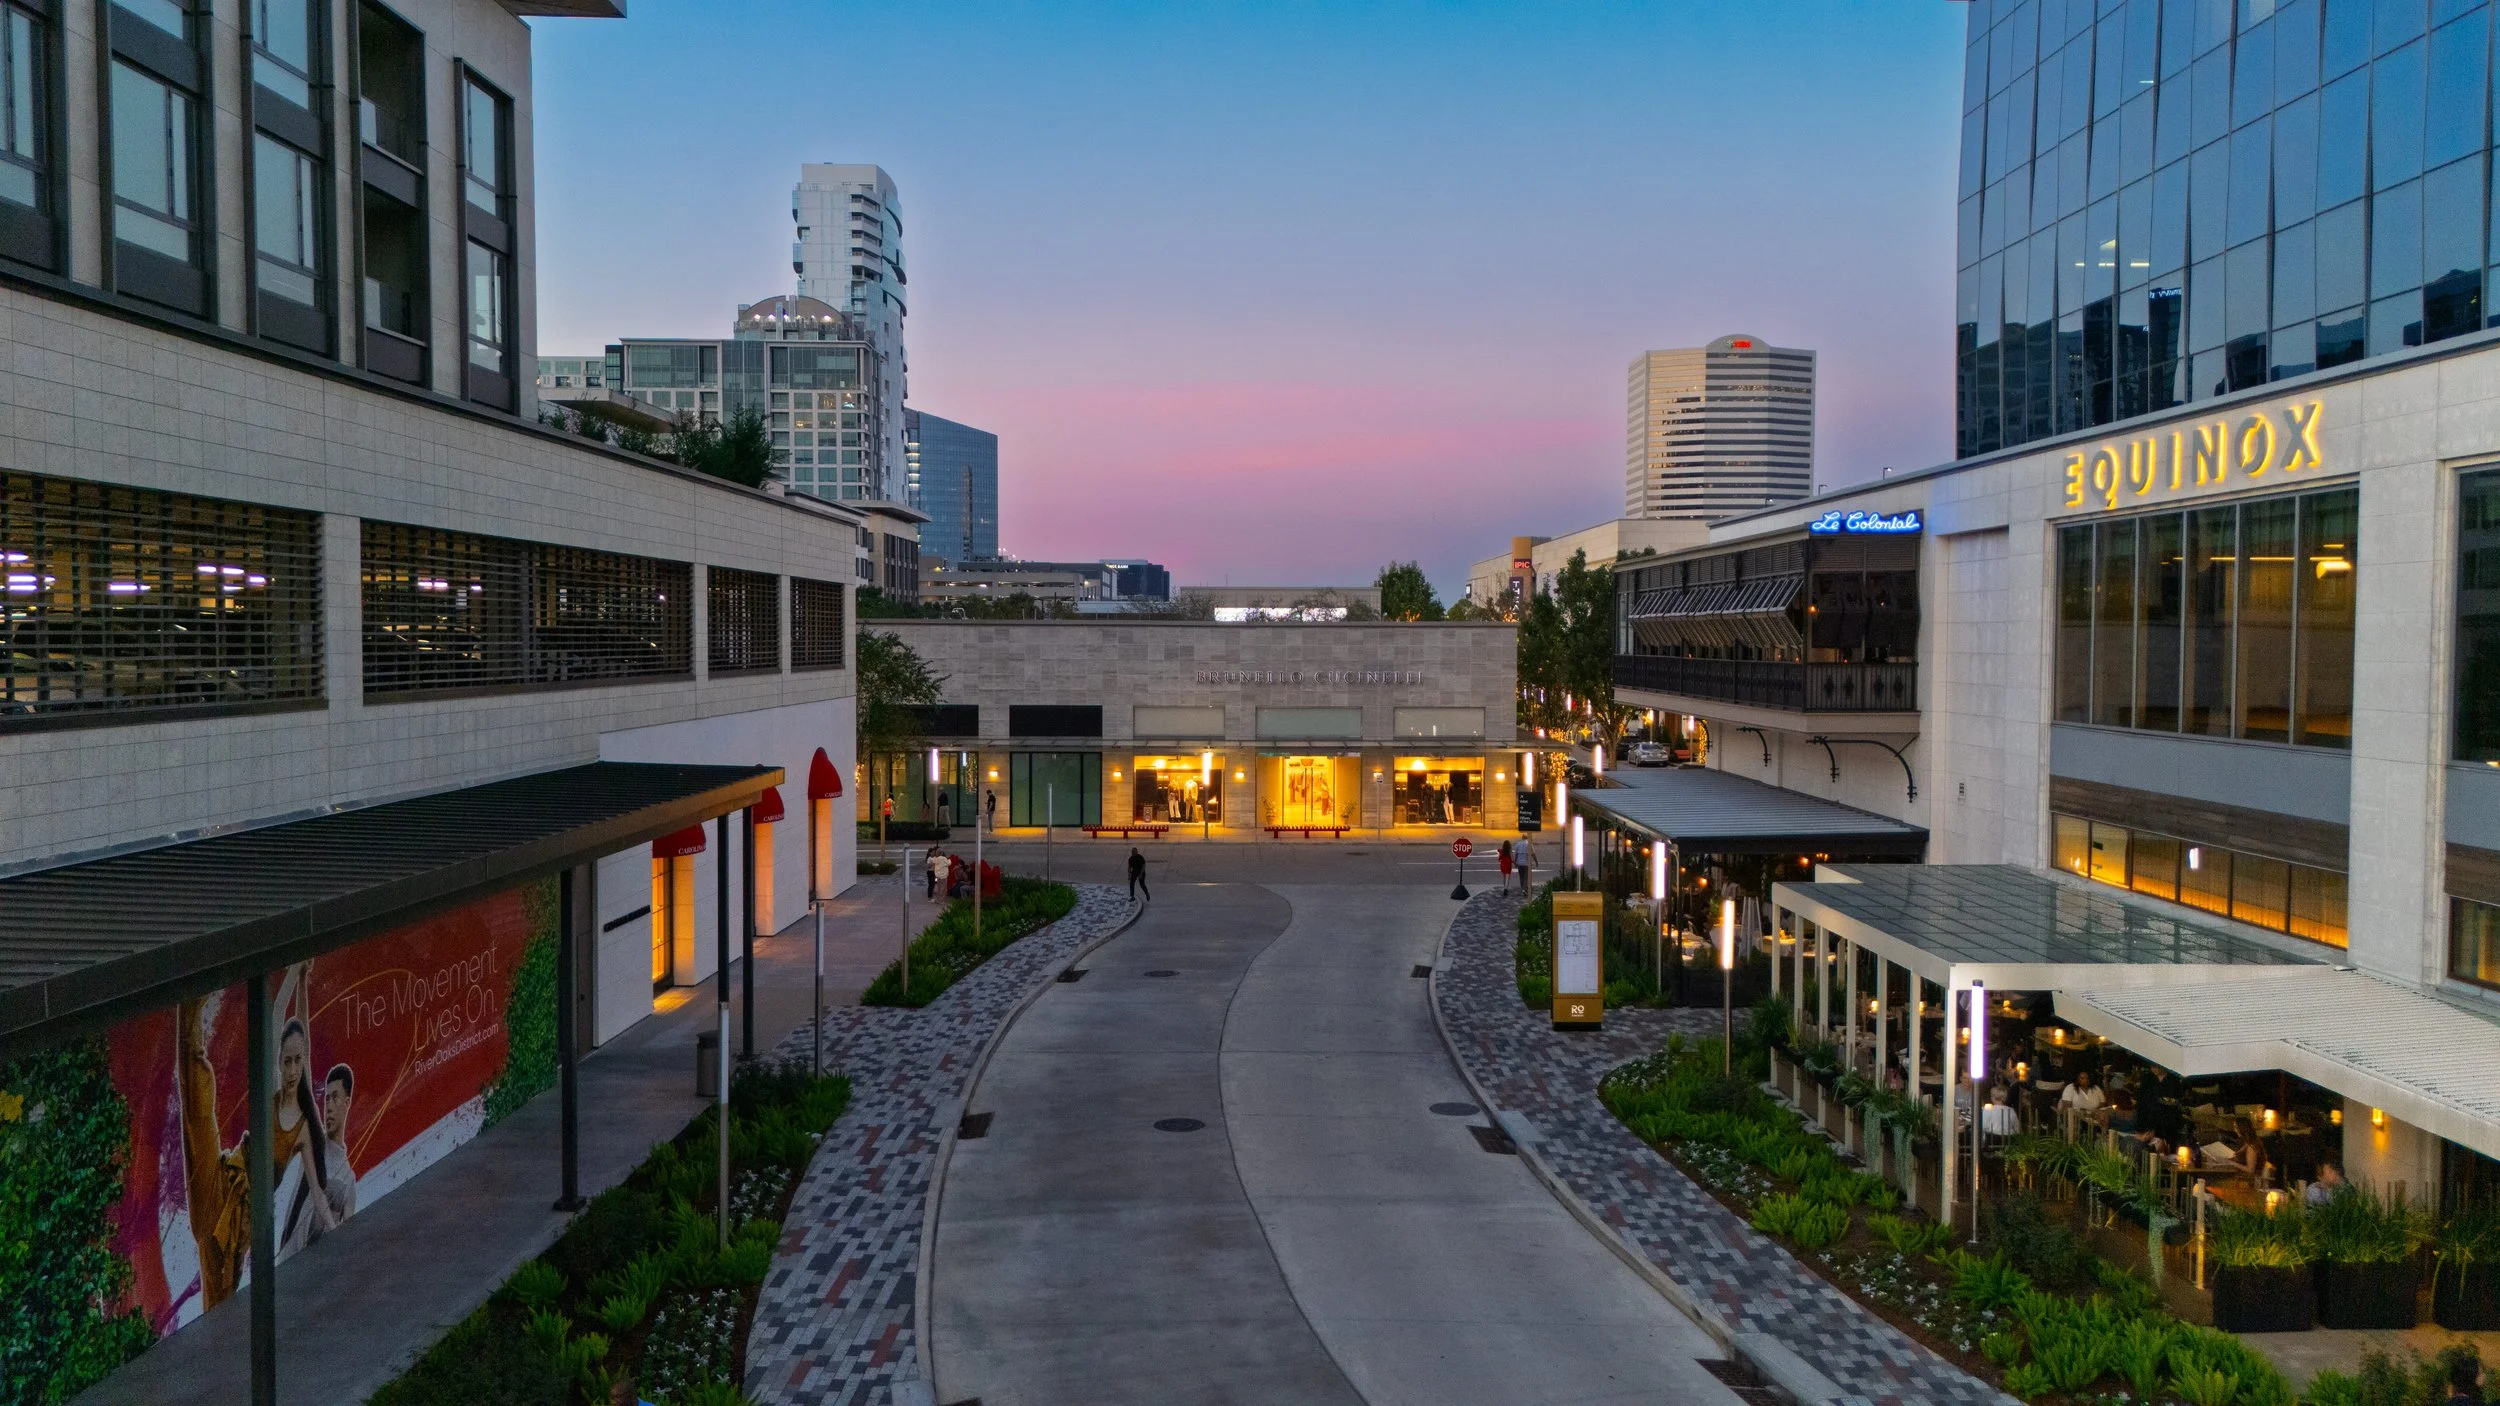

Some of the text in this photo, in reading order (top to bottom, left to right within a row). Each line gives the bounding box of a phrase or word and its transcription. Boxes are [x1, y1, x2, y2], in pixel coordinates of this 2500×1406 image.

[2062, 400, 2323, 510] EQUINOX
[1811, 511, 1920, 530] Le Colonial
[1195, 670, 1424, 685] BRUNELLO CUCINELLI
[1453, 844, 1472, 853] STOP
[340, 940, 498, 1038] The Movement
[414, 984, 499, 1052] Lives On.
[1571, 1004, 1585, 1014] RO
[414, 1022, 499, 1076] RiverOaksDistrict.com
